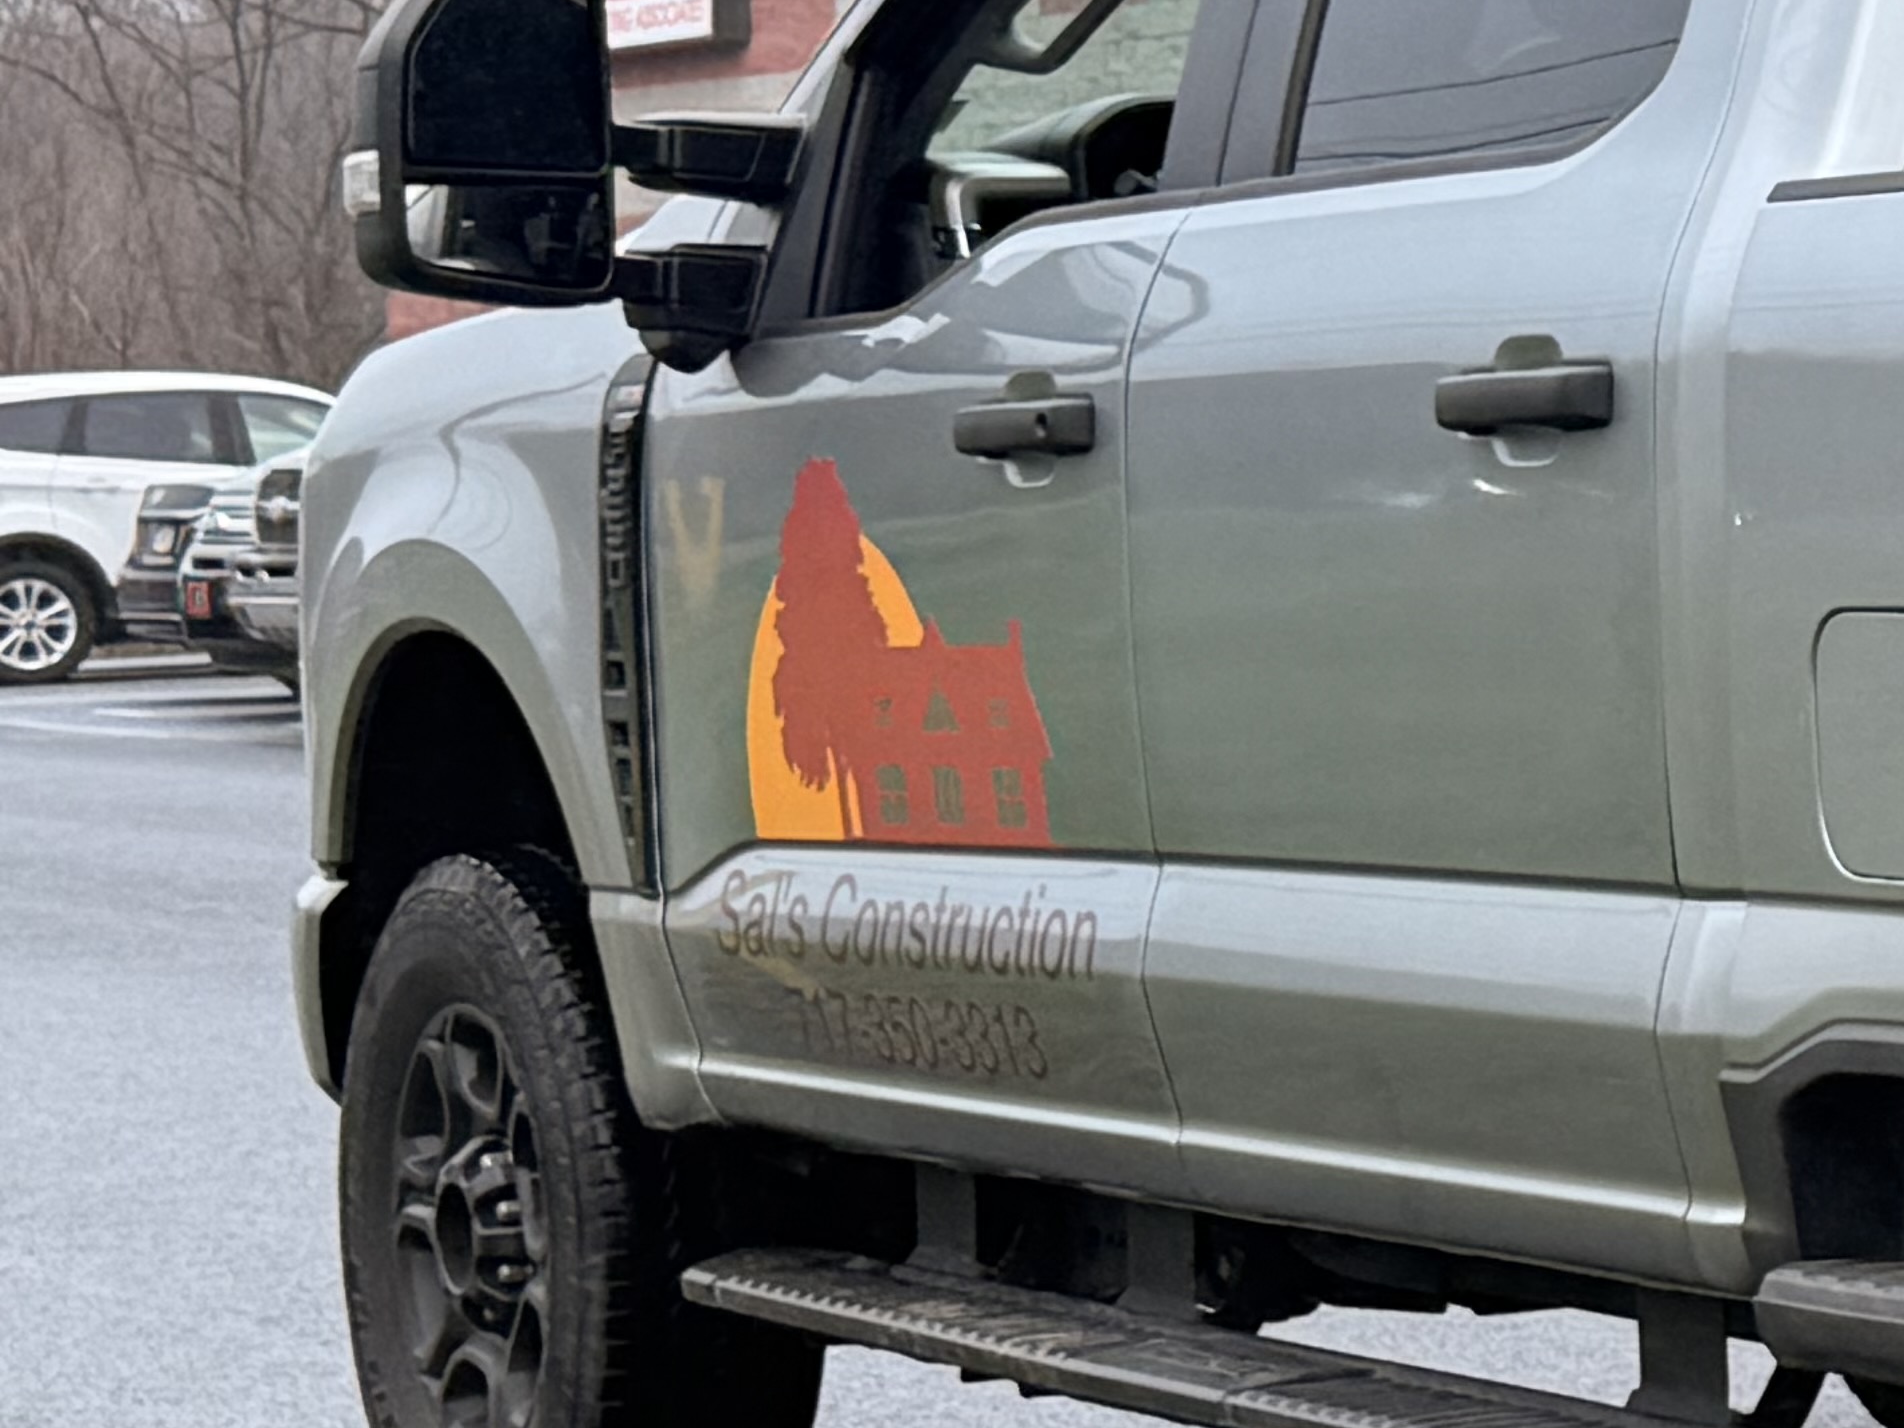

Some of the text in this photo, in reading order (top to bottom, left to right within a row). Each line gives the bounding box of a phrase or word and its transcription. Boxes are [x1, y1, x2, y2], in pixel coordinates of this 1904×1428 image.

[717, 869, 1098, 981] Sal's Construction
[784, 985, 1048, 1079] 717-350-3313
